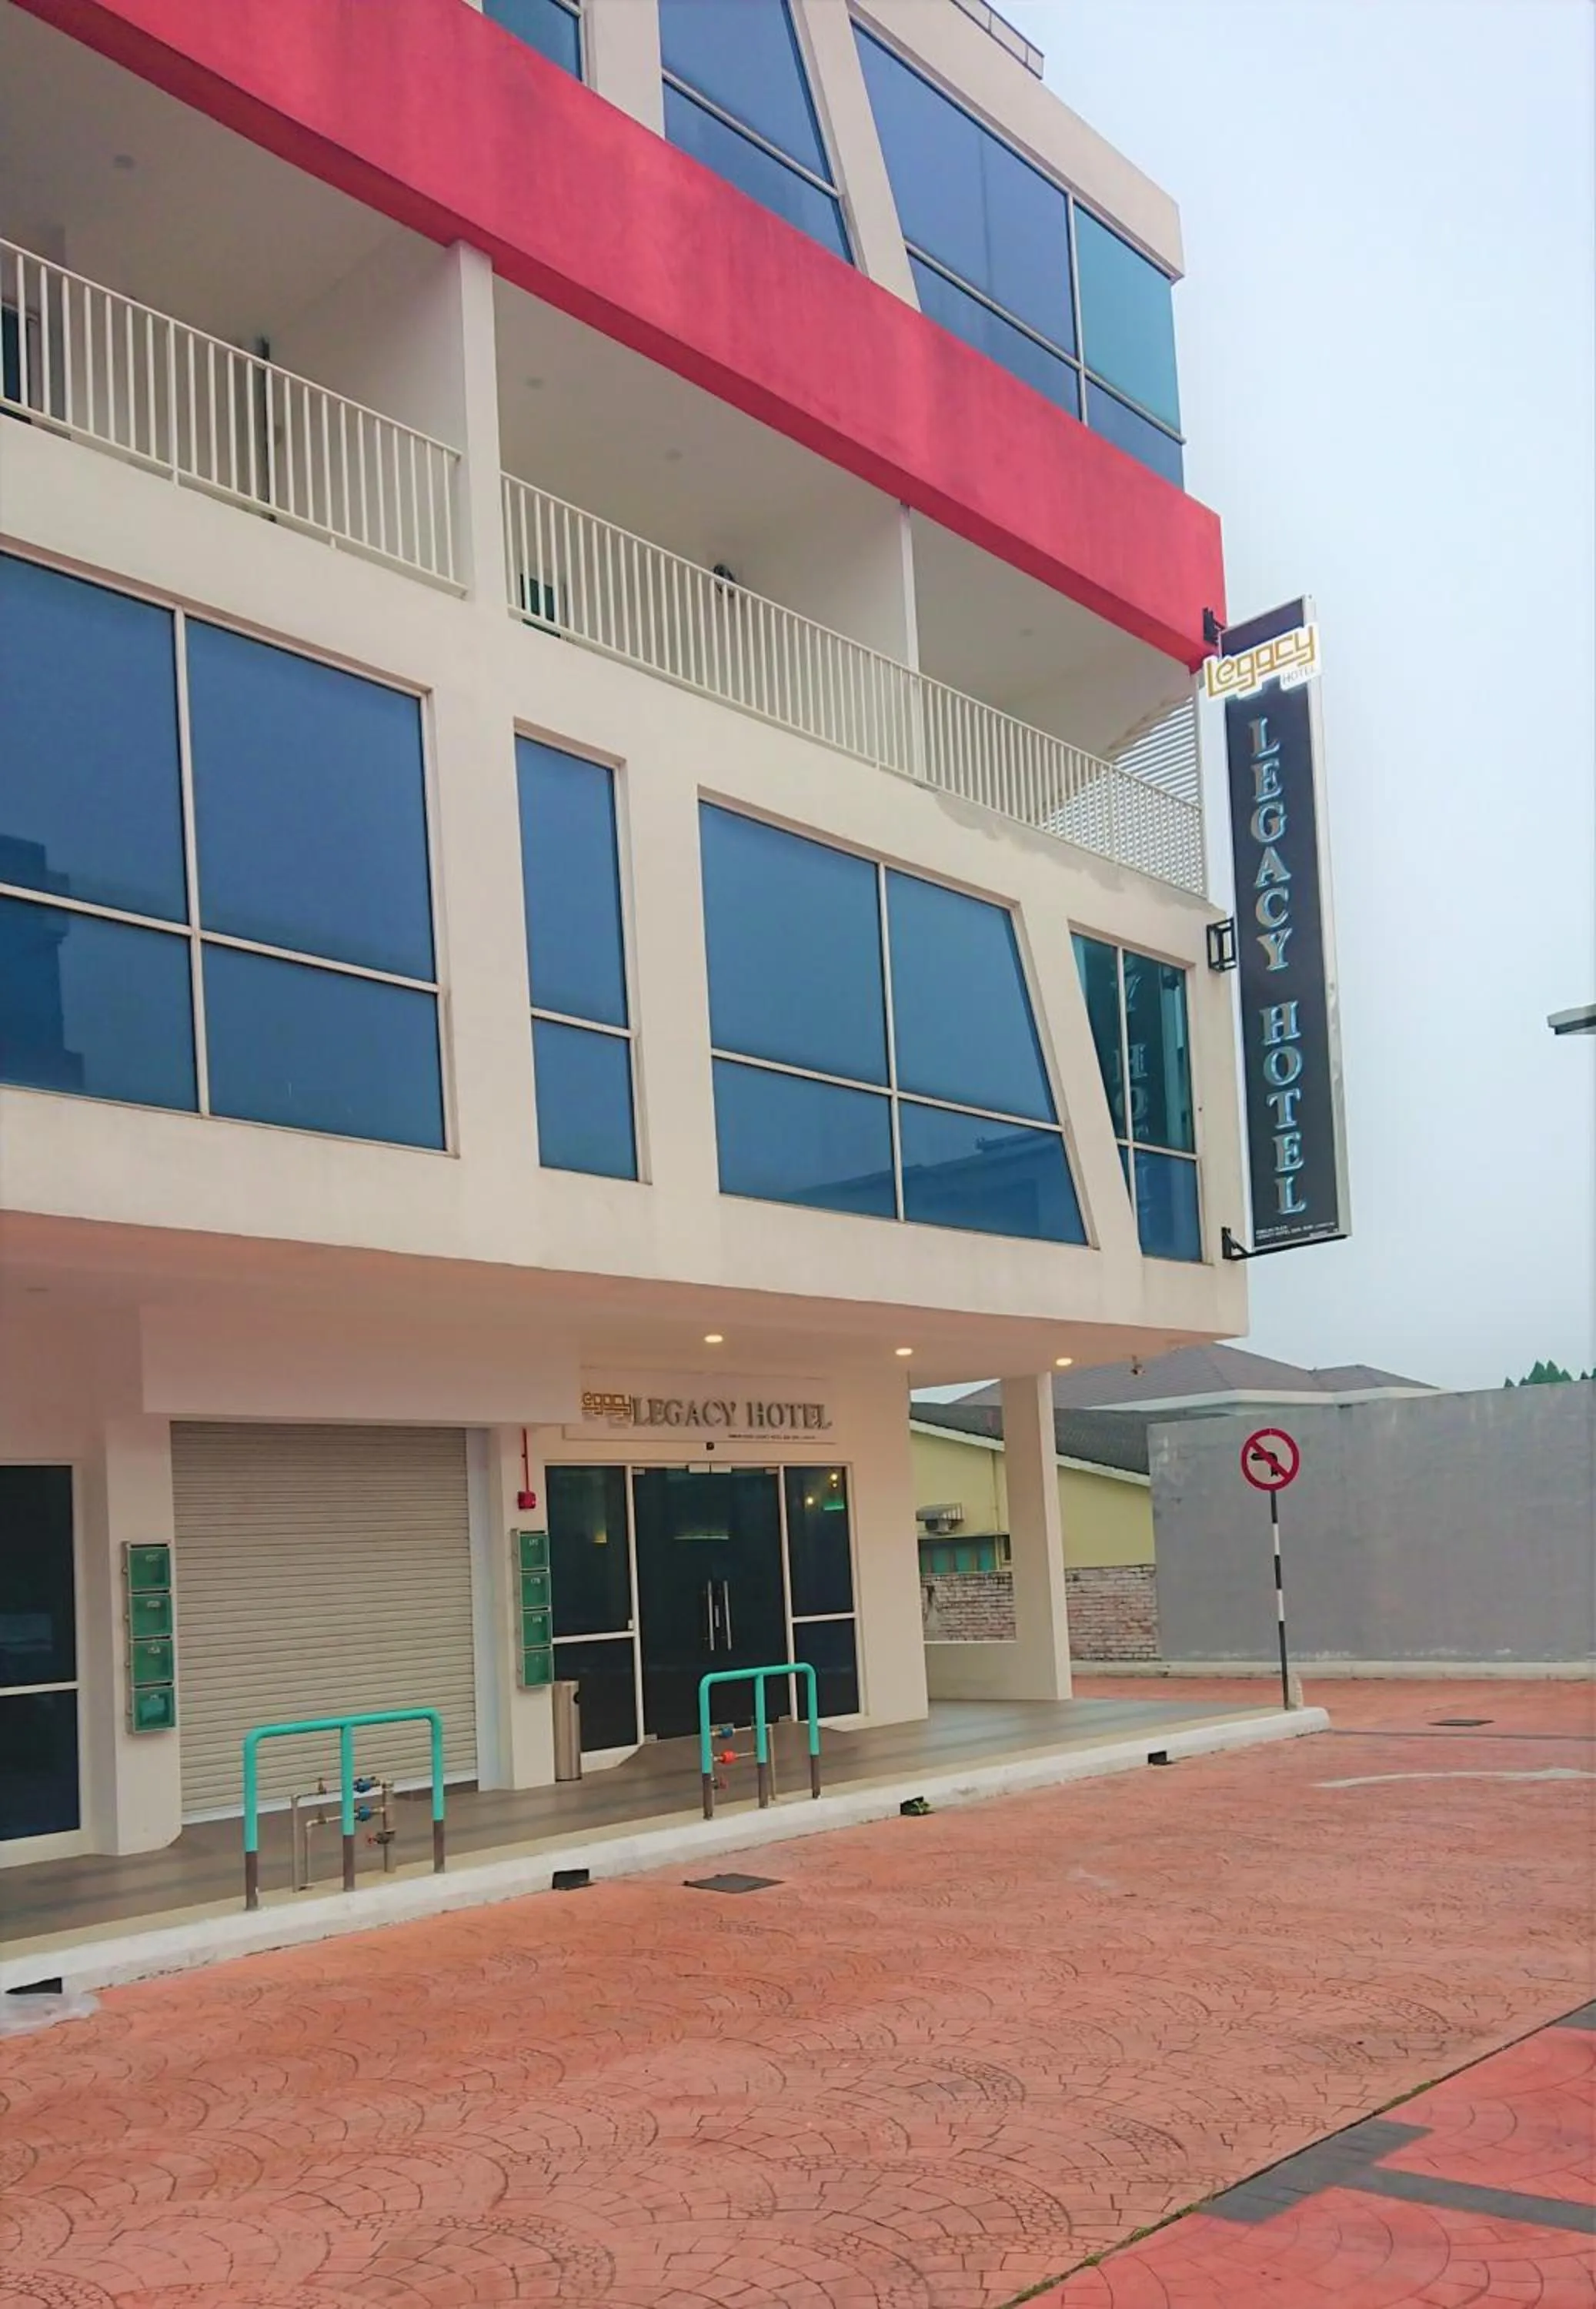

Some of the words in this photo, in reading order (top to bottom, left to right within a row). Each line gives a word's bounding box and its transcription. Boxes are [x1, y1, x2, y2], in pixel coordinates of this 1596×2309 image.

[1282, 665, 1314, 685] HOTEL
[1248, 717, 1293, 971] LEGACY
[1259, 1001, 1307, 1215] HOTEL
[582, 1392, 632, 1415] egacy
[632, 1396, 736, 1427] LEGACY
[746, 1402, 833, 1429] HOTEL
